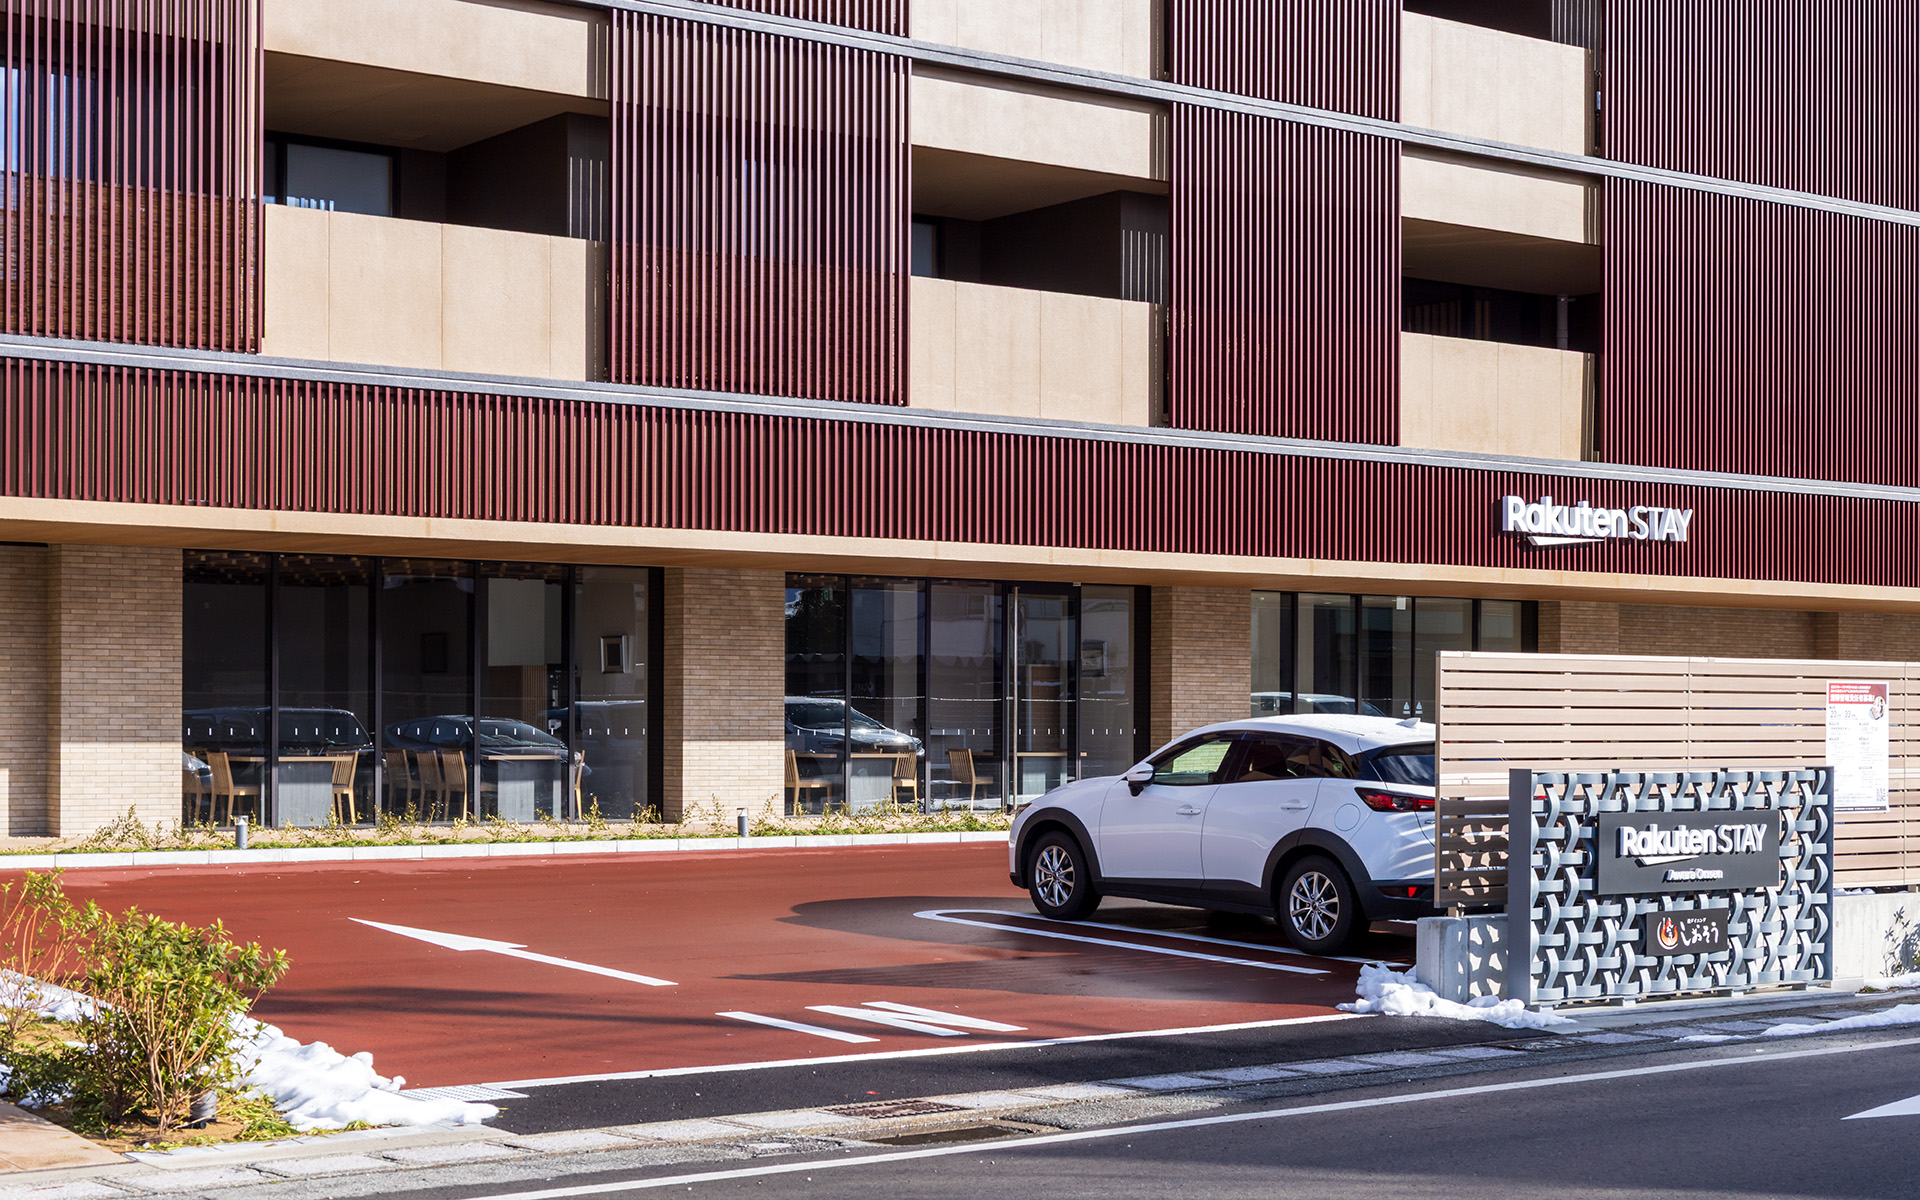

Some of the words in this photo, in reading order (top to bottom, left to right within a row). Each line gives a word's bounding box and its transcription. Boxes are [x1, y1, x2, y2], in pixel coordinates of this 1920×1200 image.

[1503, 495, 1628, 538] Rakuten
[1628, 505, 1693, 542] STAY
[1620, 823, 1718, 856] Rakuten
[1718, 823, 1767, 853] STAY
[1667, 869, 1695, 881] Awara
[1695, 868, 1723, 879] Onsen
[1680, 921, 1719, 946] しおそう
[715, 1001, 1028, 1043] IN
